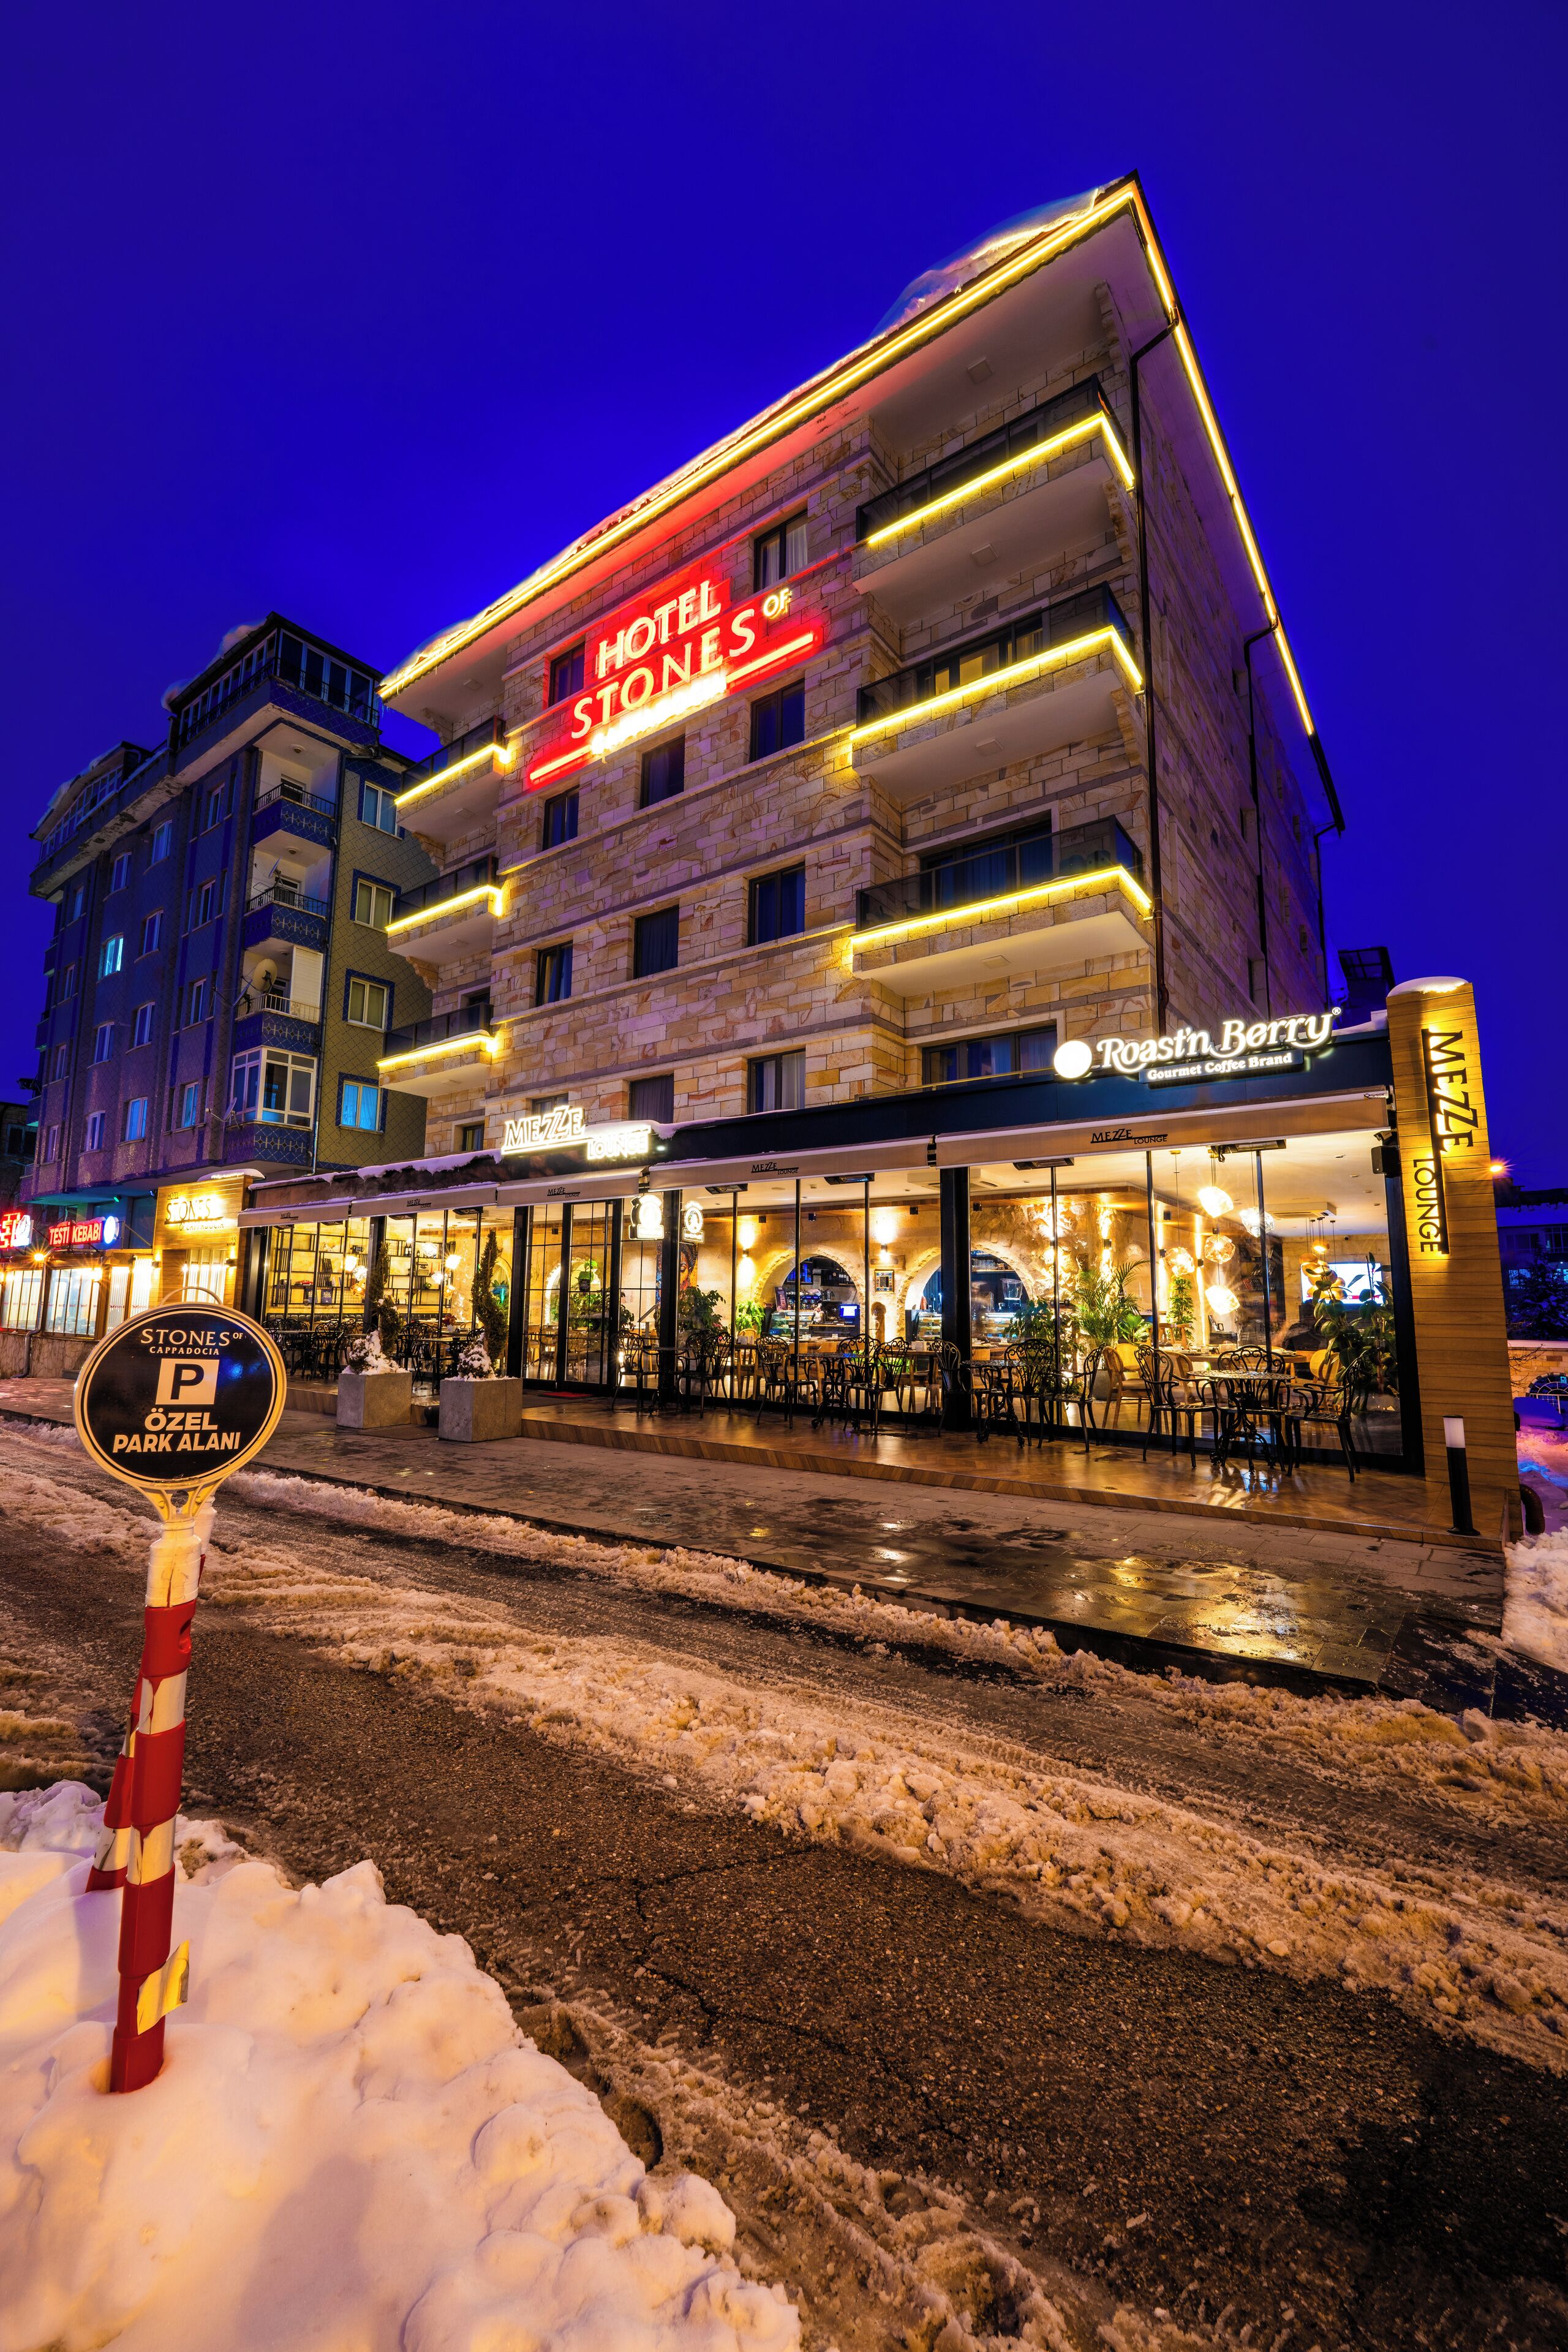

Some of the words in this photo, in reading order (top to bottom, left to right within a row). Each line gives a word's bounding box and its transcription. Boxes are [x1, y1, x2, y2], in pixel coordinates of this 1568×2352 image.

[597, 581, 722, 680] HOTEL
[571, 609, 755, 739] STONES
[763, 587, 792, 619] OF
[1096, 1028, 1212, 1074] Roast'n
[1210, 1014, 1333, 1058] Berry
[1147, 1064, 1202, 1080] Gourmet
[1205, 1059, 1245, 1074] Coffee
[1249, 1052, 1292, 1069] Brand
[1430, 1030, 1479, 1152] MEZZE
[504, 1105, 586, 1149] MEZZE
[1091, 1128, 1133, 1142] MEZZE
[587, 1133, 649, 1160] LOUNGE
[752, 1162, 778, 1172] MEZZE
[548, 1186, 566, 1195] MEZZE
[1413, 1158, 1442, 1252] LOUNGE
[72, 1223, 102, 1243] KEBABI
[140, 1329, 230, 1346] STONES
[149, 1346, 220, 1355] CAPPADOCIA
[170, 1363, 205, 1400] P
[145, 1408, 218, 1431] ÖZEL
[113, 1433, 174, 1453] PARK
[176, 1432, 241, 1452] ALANI
